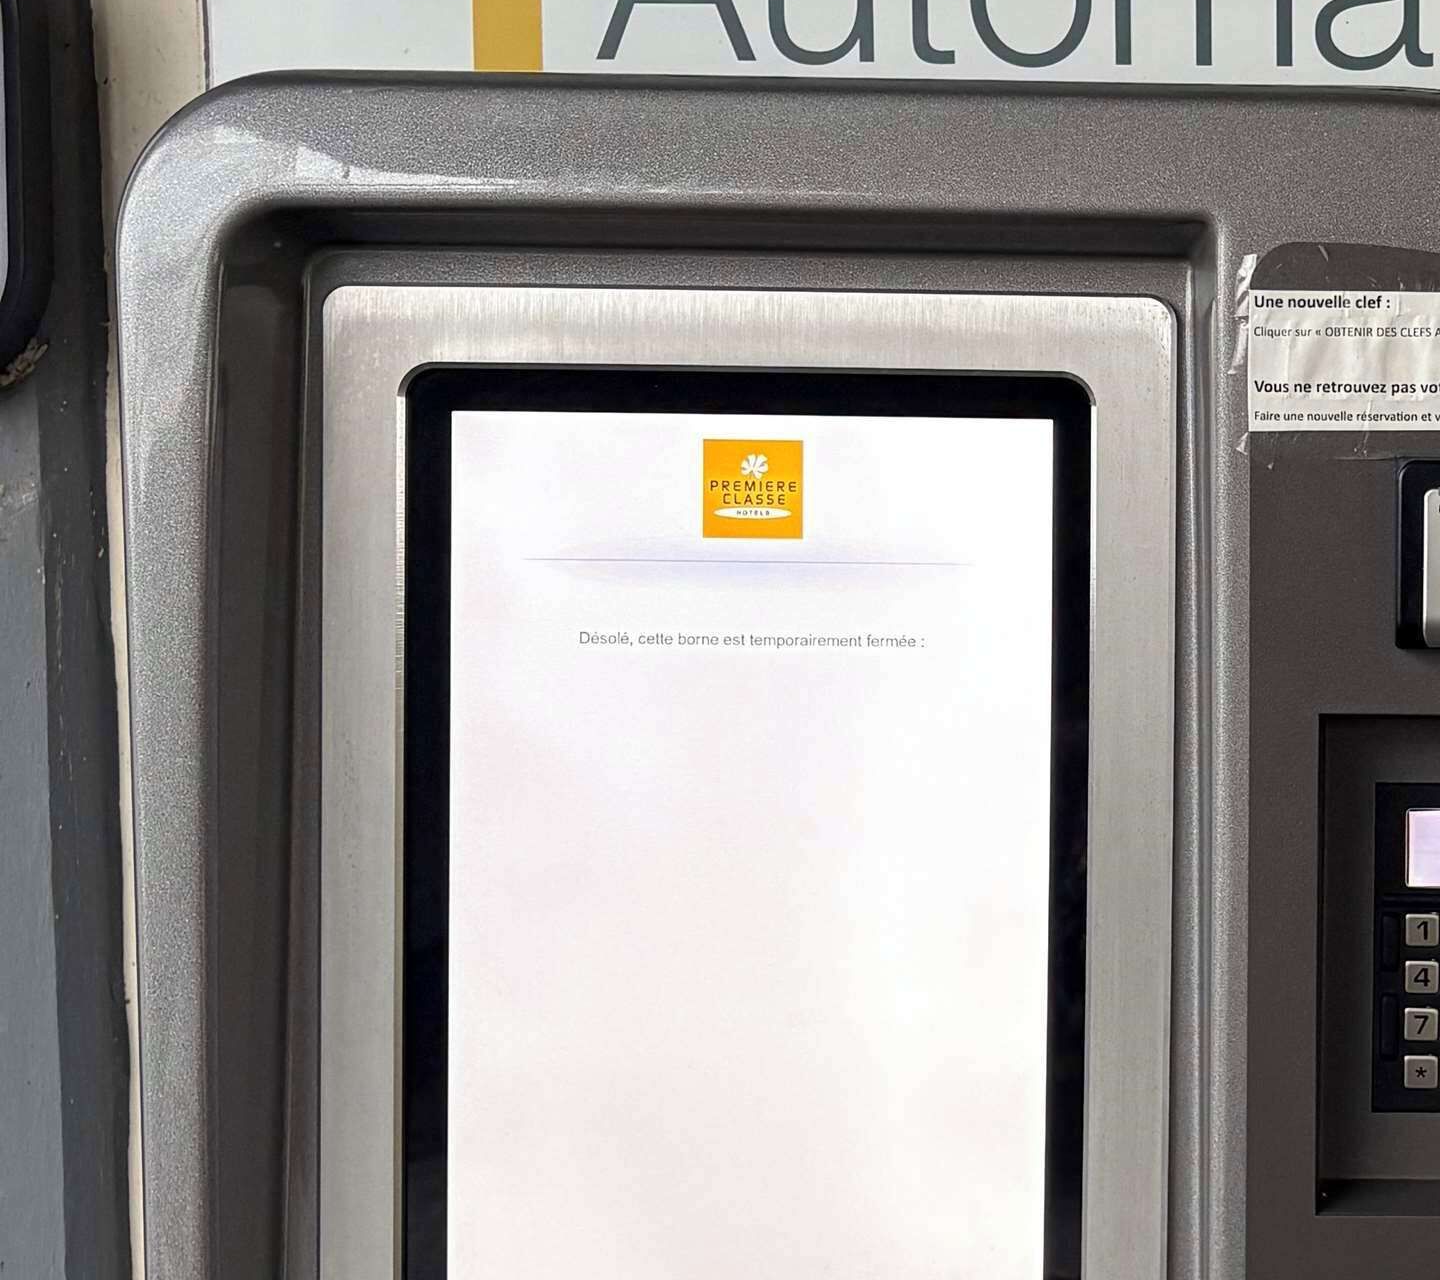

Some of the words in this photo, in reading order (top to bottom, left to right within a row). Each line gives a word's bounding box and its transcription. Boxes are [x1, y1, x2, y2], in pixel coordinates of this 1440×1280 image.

[1254, 295, 1284, 309] Une
[1287, 294, 1351, 309] nouvelle
[1355, 295, 1383, 309] clef
[1253, 326, 1293, 339] Cliquer
[1294, 328, 1312, 337] sur
[1324, 326, 1373, 337] OBTENIR
[1376, 326, 1398, 338] DES
[1400, 327, 1432, 338] CLEFS
[1253, 379, 1290, 393] Vous
[1293, 382, 1312, 394] ne
[1316, 381, 1387, 394] retrouvez
[1391, 383, 1417, 397] pas
[1254, 410, 1281, 422] Faire
[1283, 413, 1304, 422] une
[1306, 410, 1354, 422] nouvelle
[1356, 411, 1418, 422] réservation
[1420, 412, 1432, 422] et
[710, 479, 797, 493] PREMIERE
[722, 493, 786, 506] CLASSE
[579, 631, 633, 647] Désolé,
[637, 632, 674, 646] cette
[677, 632, 720, 646] borne
[722, 633, 746, 646] est
[749, 633, 862, 649] temporairement
[866, 633, 917, 648] fermée
[1416, 920, 1429, 940] 1
[1414, 968, 1430, 987] 4
[1414, 1015, 1429, 1035] 7
